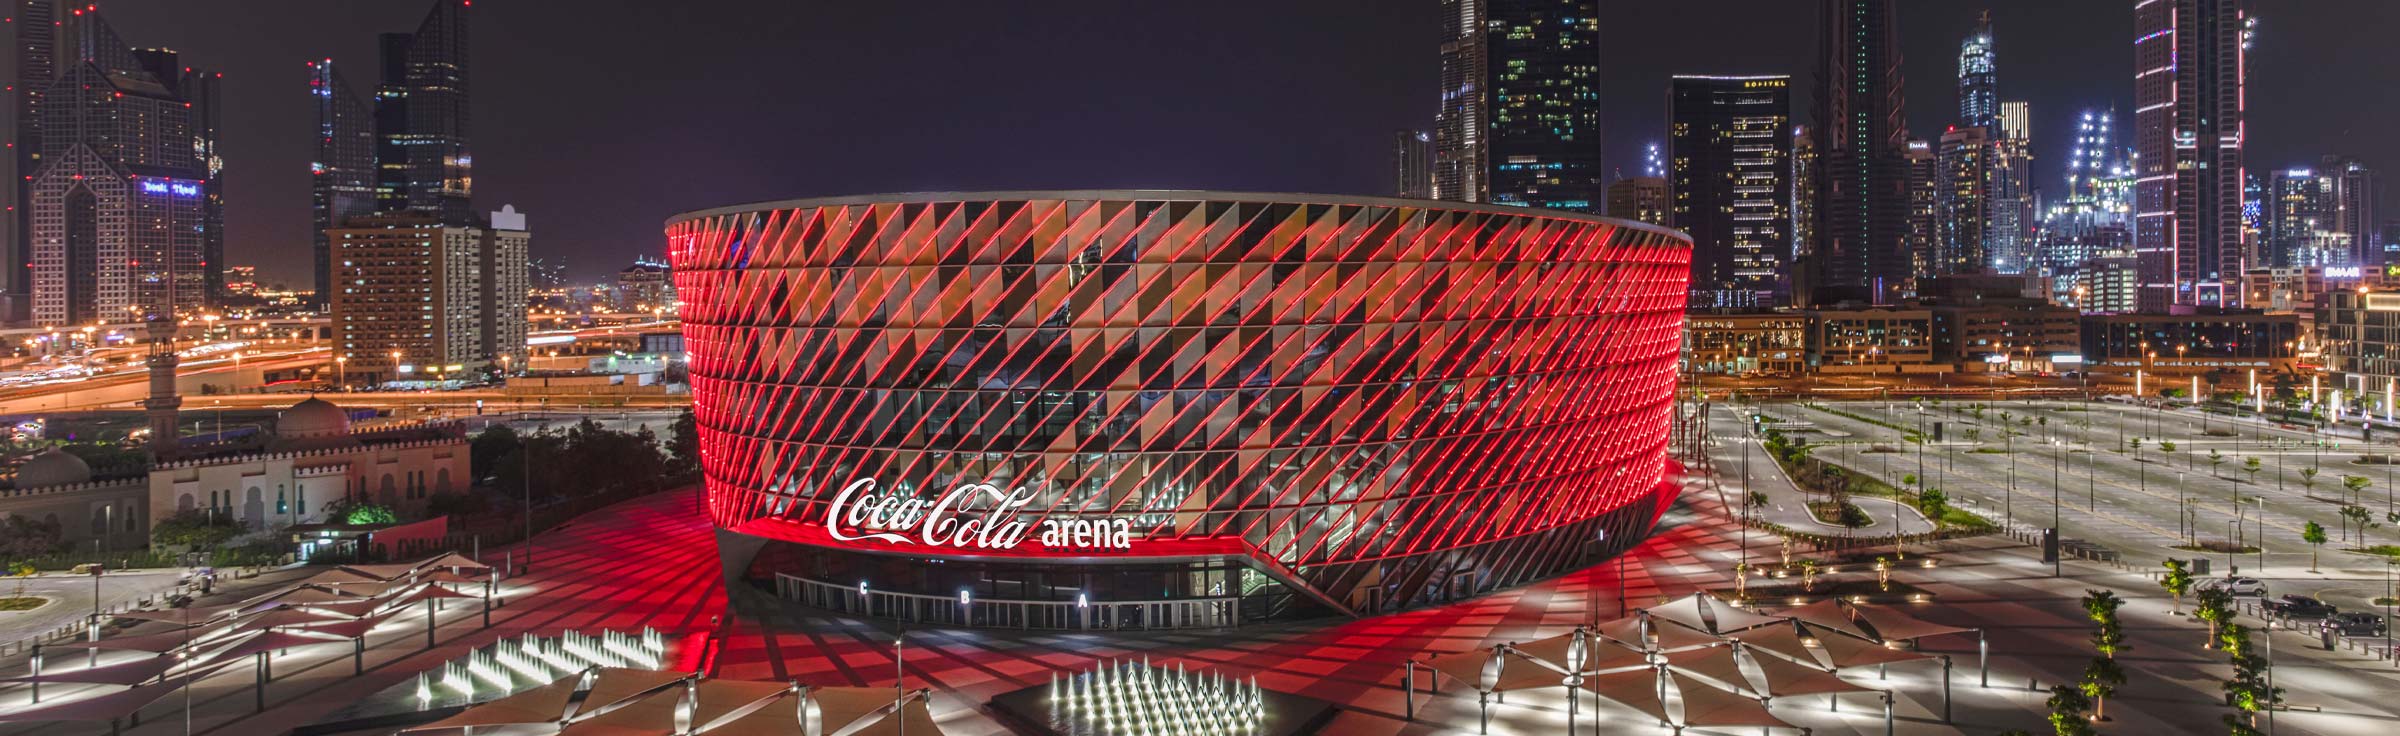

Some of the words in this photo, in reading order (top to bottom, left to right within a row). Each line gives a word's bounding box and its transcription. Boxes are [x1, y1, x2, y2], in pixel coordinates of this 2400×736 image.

[1744, 80, 1786, 88] SOFITEL
[2325, 267, 2359, 277] EMAAR
[1042, 517, 1130, 548] arena
[860, 581, 867, 594] C
[960, 590, 970, 604] B
[1078, 593, 1088, 607] A
